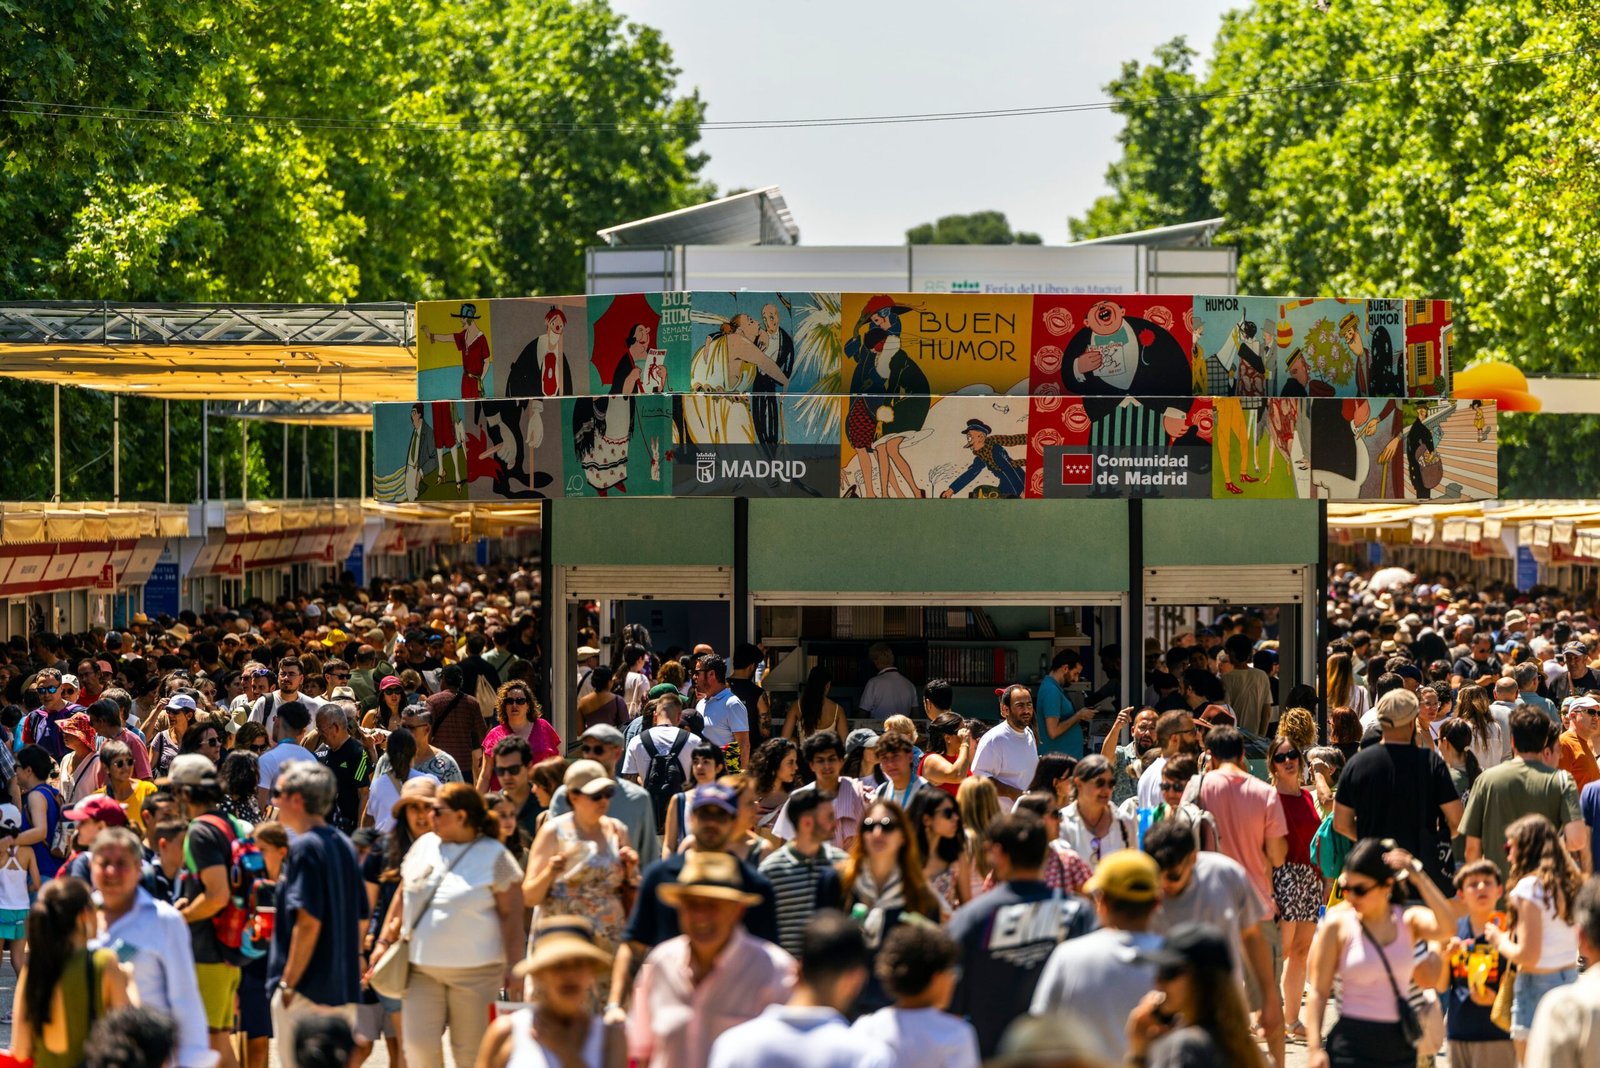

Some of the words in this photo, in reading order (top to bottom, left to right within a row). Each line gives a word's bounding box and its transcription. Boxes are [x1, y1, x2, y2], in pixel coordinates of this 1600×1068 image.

[985, 284, 1014, 293] Feria
[1018, 283, 1034, 293] del
[1038, 284, 1068, 293] Libro
[1205, 298, 1239, 311] HUMOR
[1368, 299, 1391, 312] BUEN
[920, 311, 1015, 334] BUEN
[1368, 313, 1400, 326] HUMOR
[919, 338, 1017, 361] HUMOR
[1096, 453, 1189, 467] Comunidad
[721, 459, 807, 483] MADRID
[1096, 471, 1120, 486] de
[1124, 471, 1188, 486] Madrid
